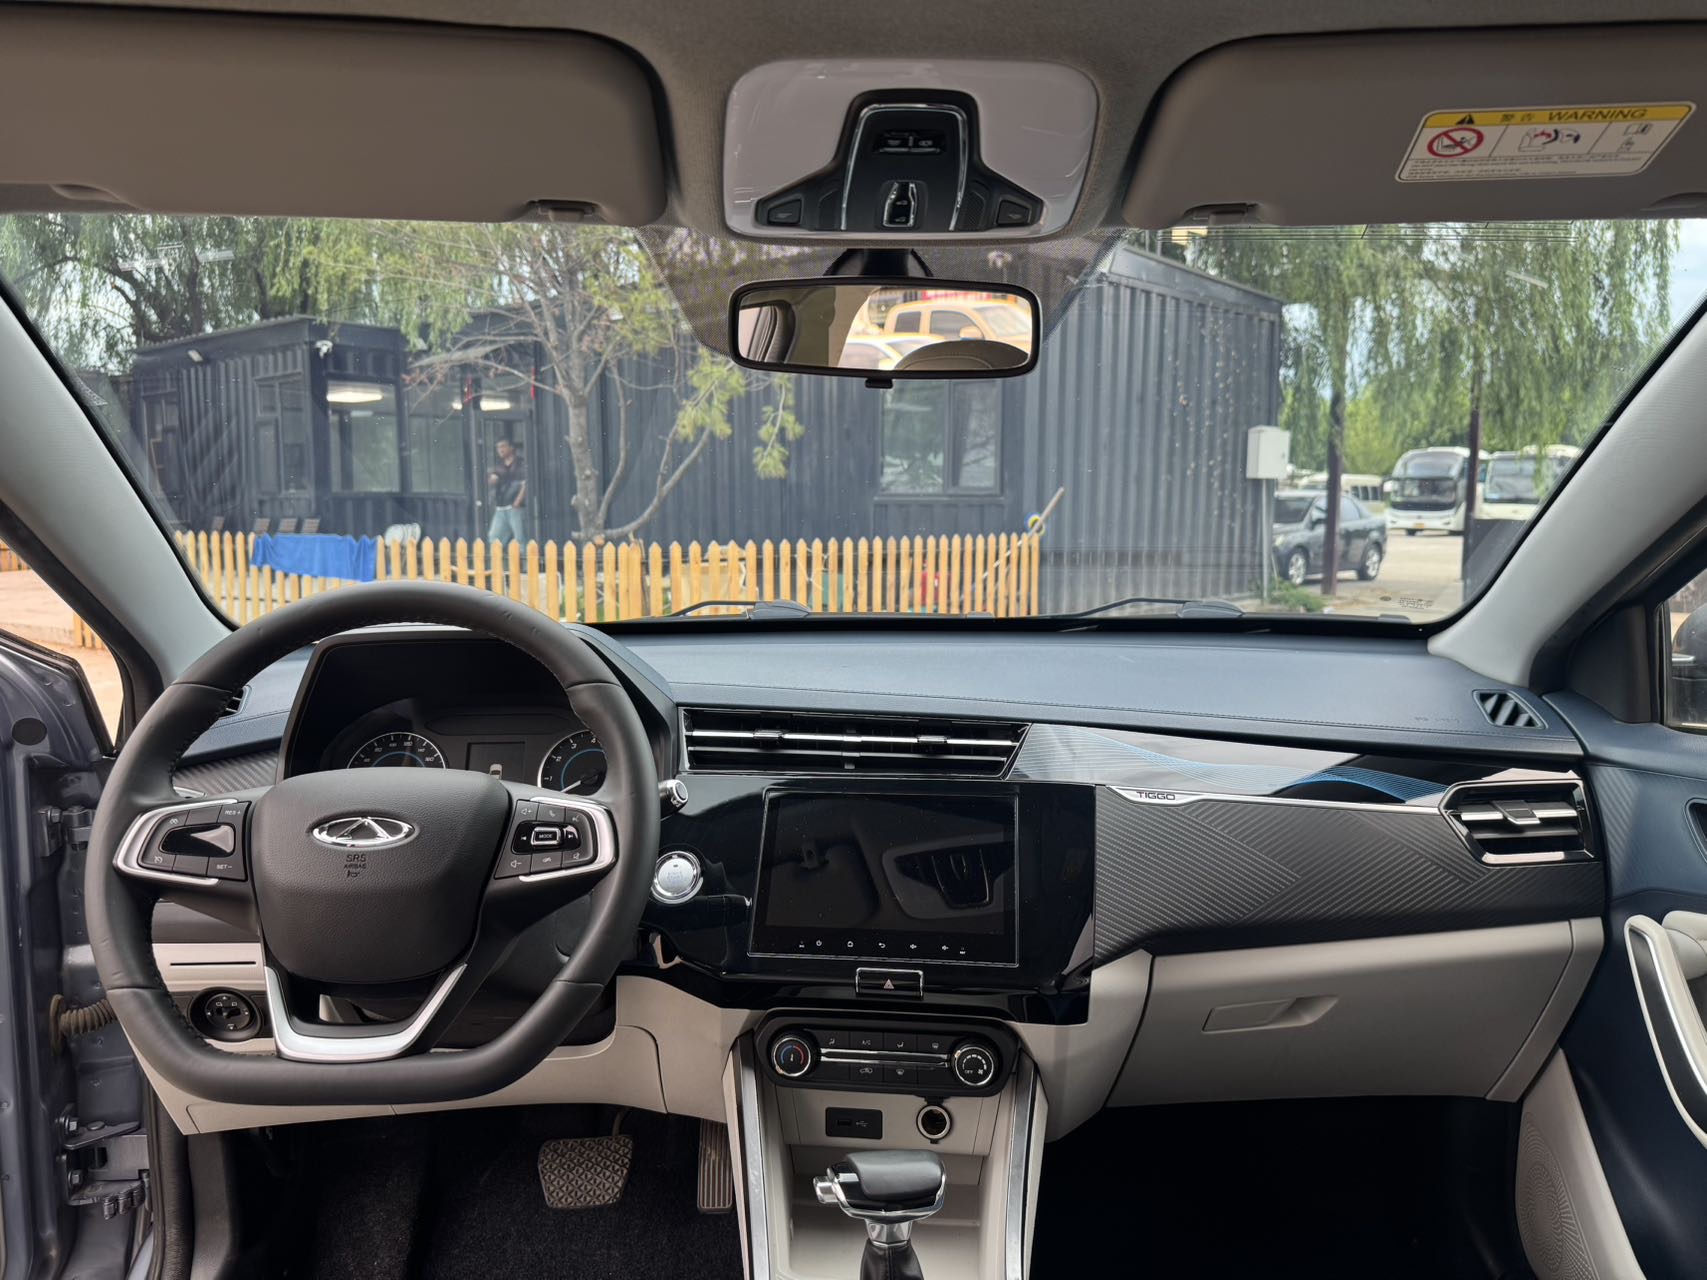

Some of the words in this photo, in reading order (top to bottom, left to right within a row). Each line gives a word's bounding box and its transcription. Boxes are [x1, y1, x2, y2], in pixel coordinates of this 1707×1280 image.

[1548, 107, 1648, 122] WARNING
[1136, 791, 1176, 801] TIGGO
[346, 853, 367, 862] SRS
